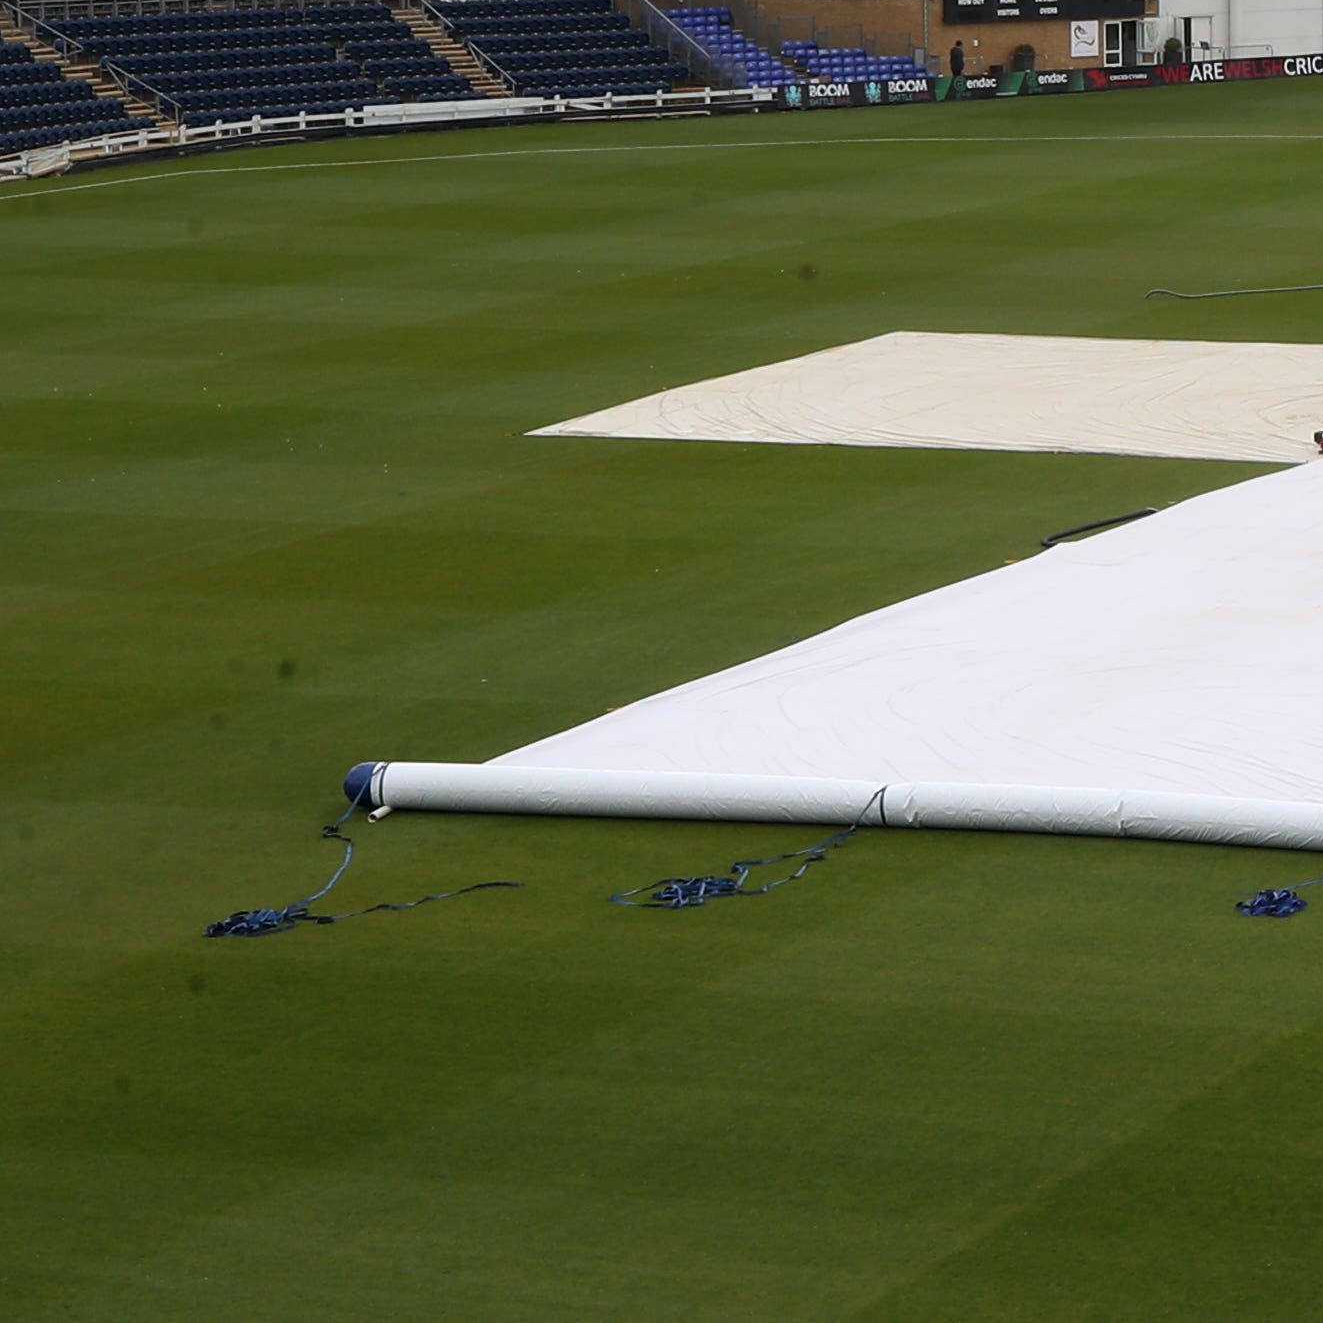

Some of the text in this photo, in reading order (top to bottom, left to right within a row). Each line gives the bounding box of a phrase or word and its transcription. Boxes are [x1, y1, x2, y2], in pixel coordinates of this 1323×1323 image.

[966, 78, 998, 90] endac
[1038, 73, 1068, 85] endac
[808, 84, 850, 97] BOOM
[887, 79, 928, 93] BOOM
